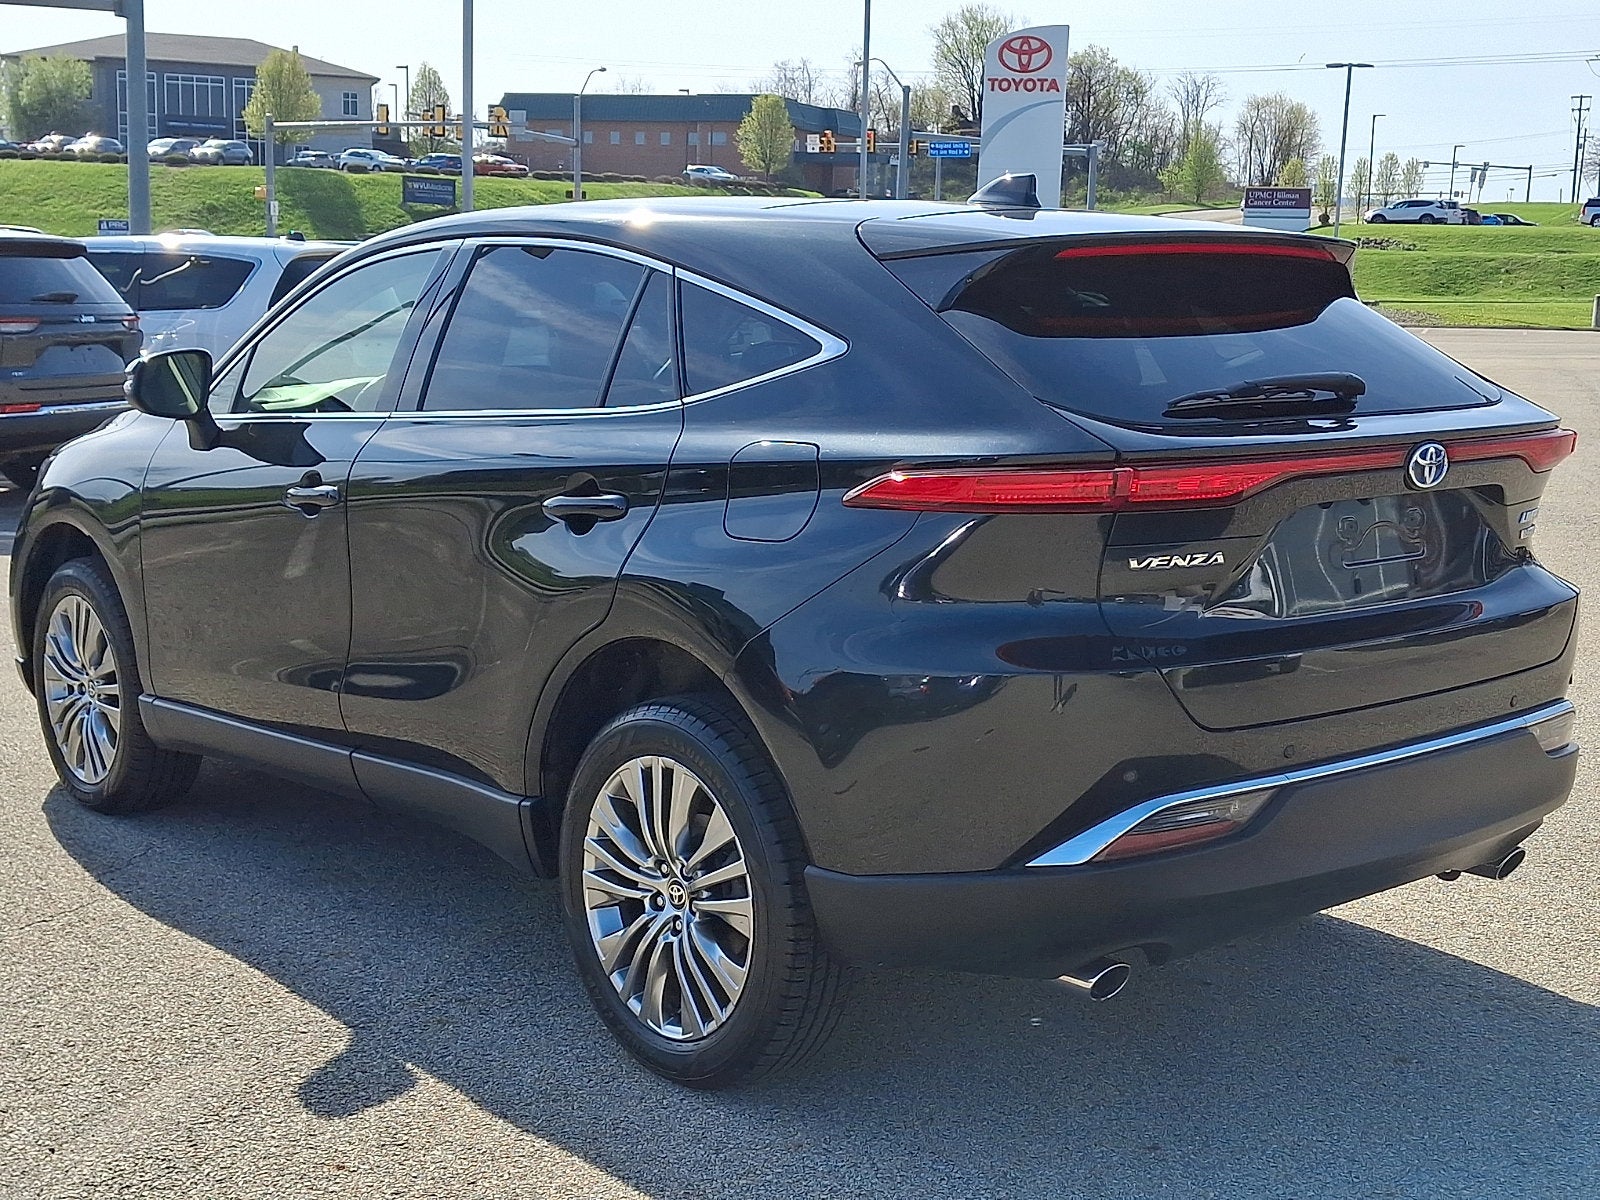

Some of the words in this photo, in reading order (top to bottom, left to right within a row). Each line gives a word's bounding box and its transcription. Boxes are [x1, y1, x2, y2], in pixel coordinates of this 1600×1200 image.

[987, 77, 1060, 93] TOYOTA
[1248, 191, 1272, 199] UPMC
[1273, 191, 1300, 199] Hillman
[1129, 552, 1224, 570] VENZA
